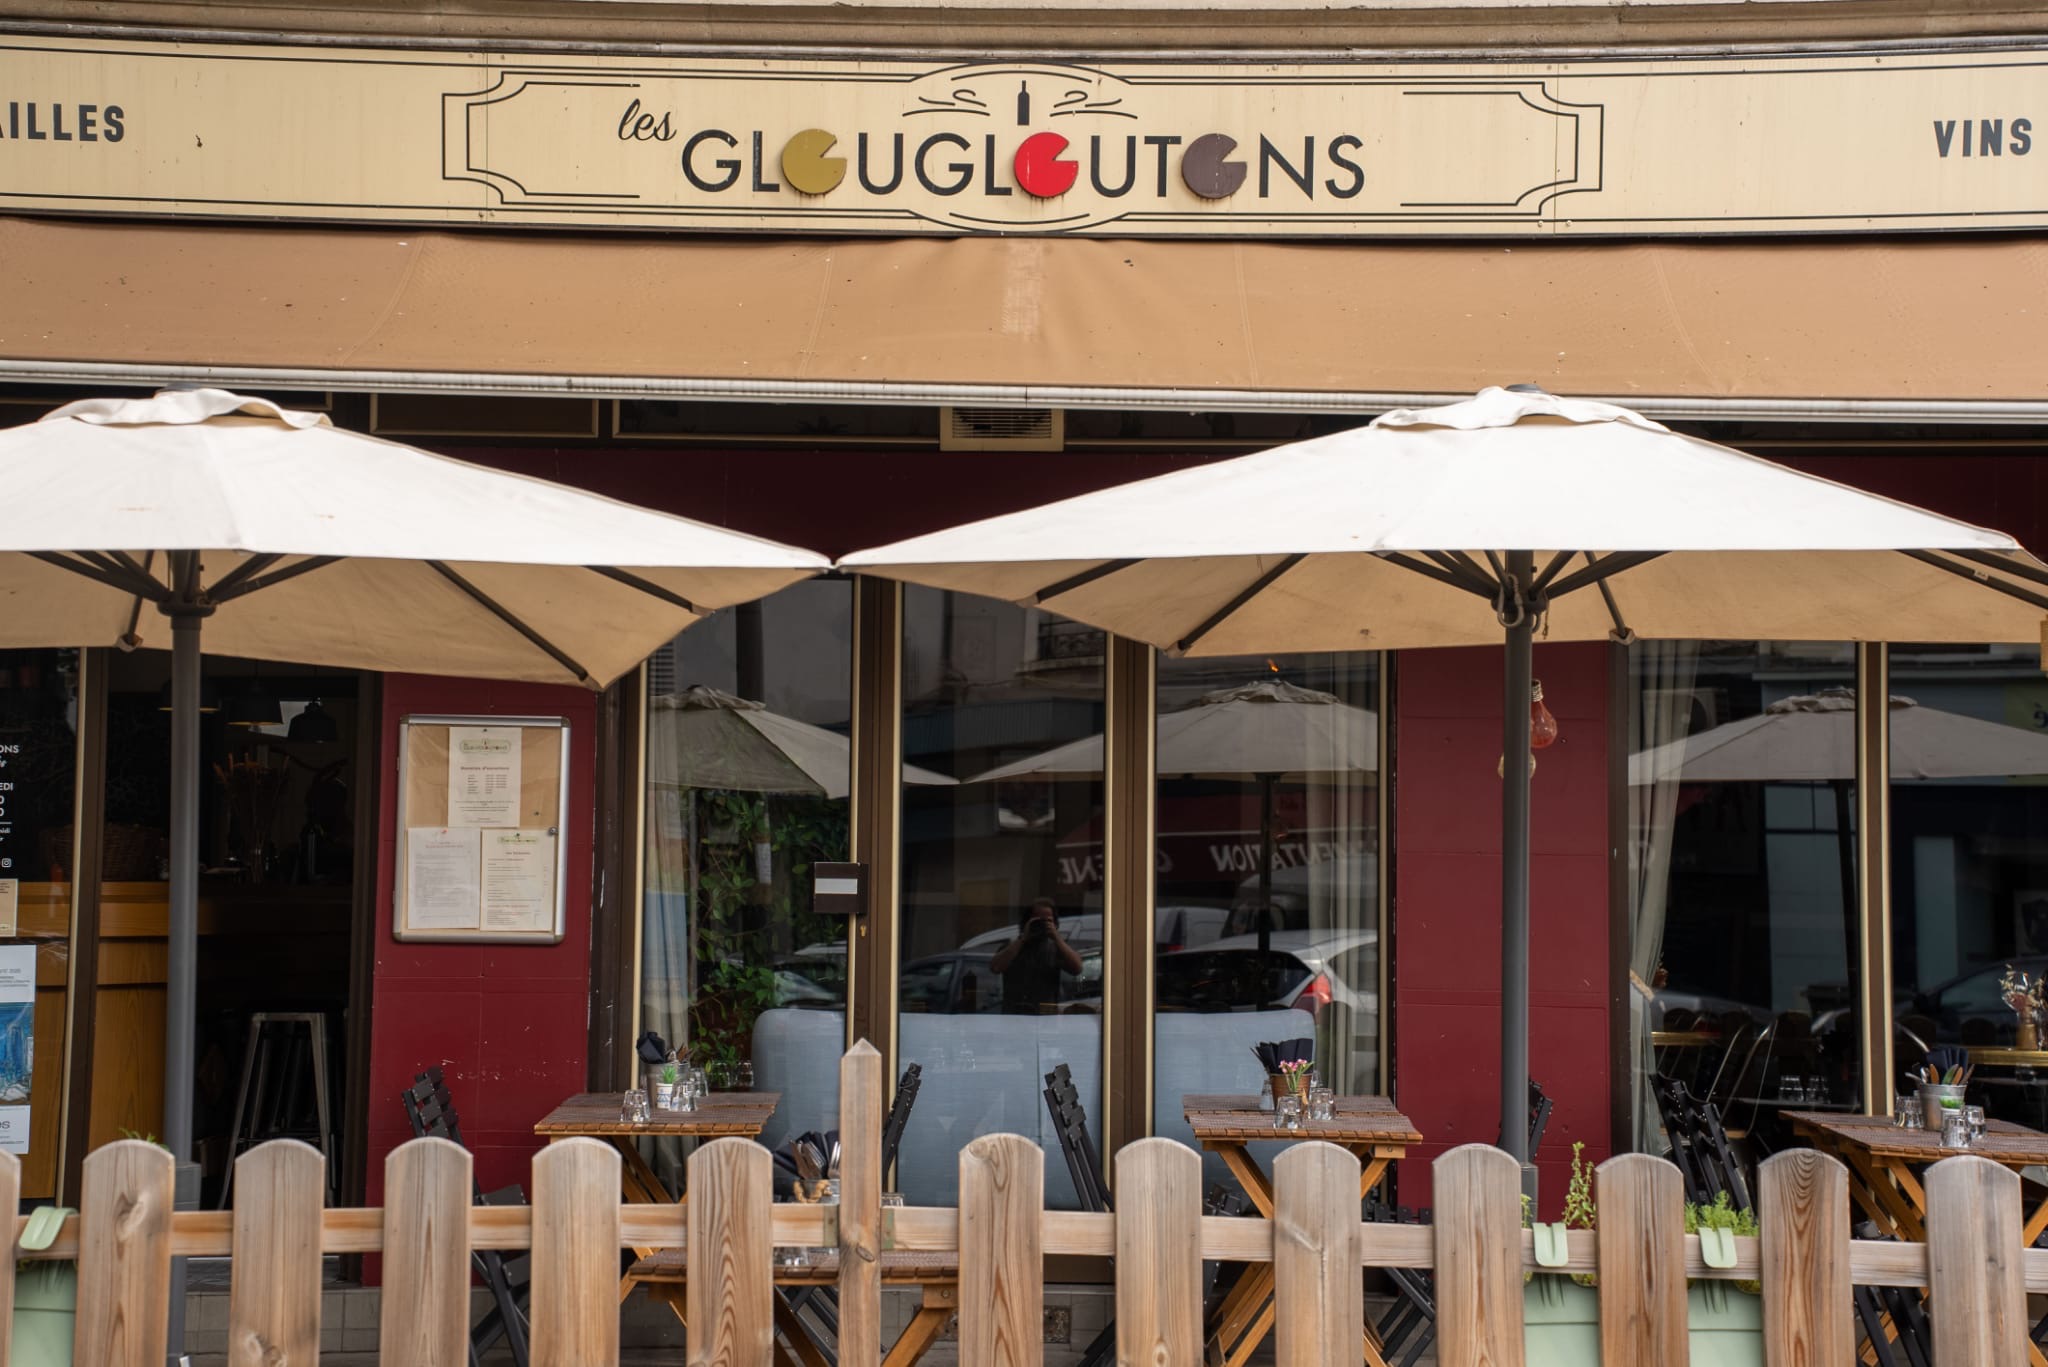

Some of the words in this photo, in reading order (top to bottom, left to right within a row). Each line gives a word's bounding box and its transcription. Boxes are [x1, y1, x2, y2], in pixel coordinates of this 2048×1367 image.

[0, 101, 125, 142] ILLES
[1933, 117, 2032, 158] VINS
[617, 98, 678, 142] les
[681, 128, 1365, 200] GLOUGLOUTONS
